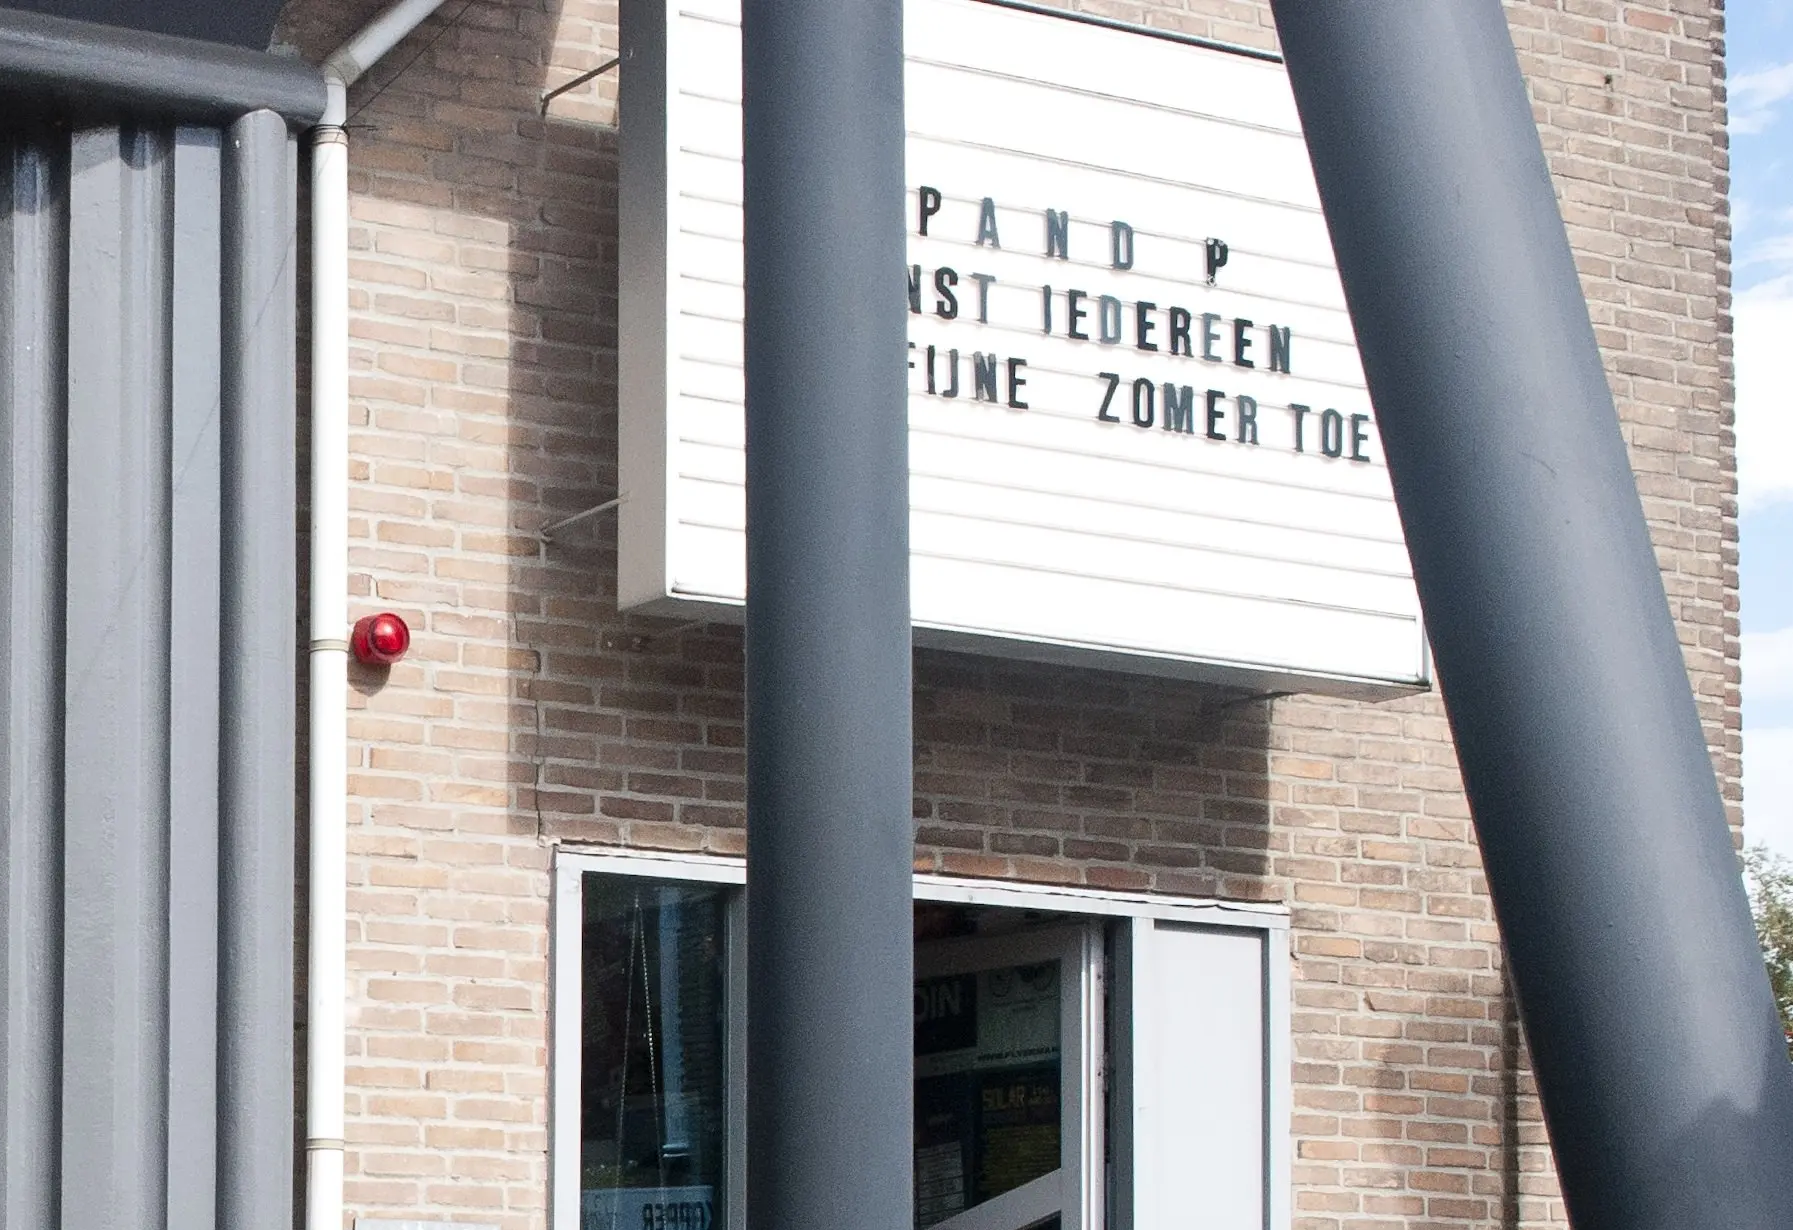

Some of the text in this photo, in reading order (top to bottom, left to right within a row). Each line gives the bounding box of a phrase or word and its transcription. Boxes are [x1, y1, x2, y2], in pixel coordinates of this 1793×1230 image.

[919, 185, 1228, 287] PAND P
[1042, 284, 1290, 375] IEDEREEN
[1097, 371, 1259, 446] ZOMER
[1288, 403, 1371, 463] TOE
